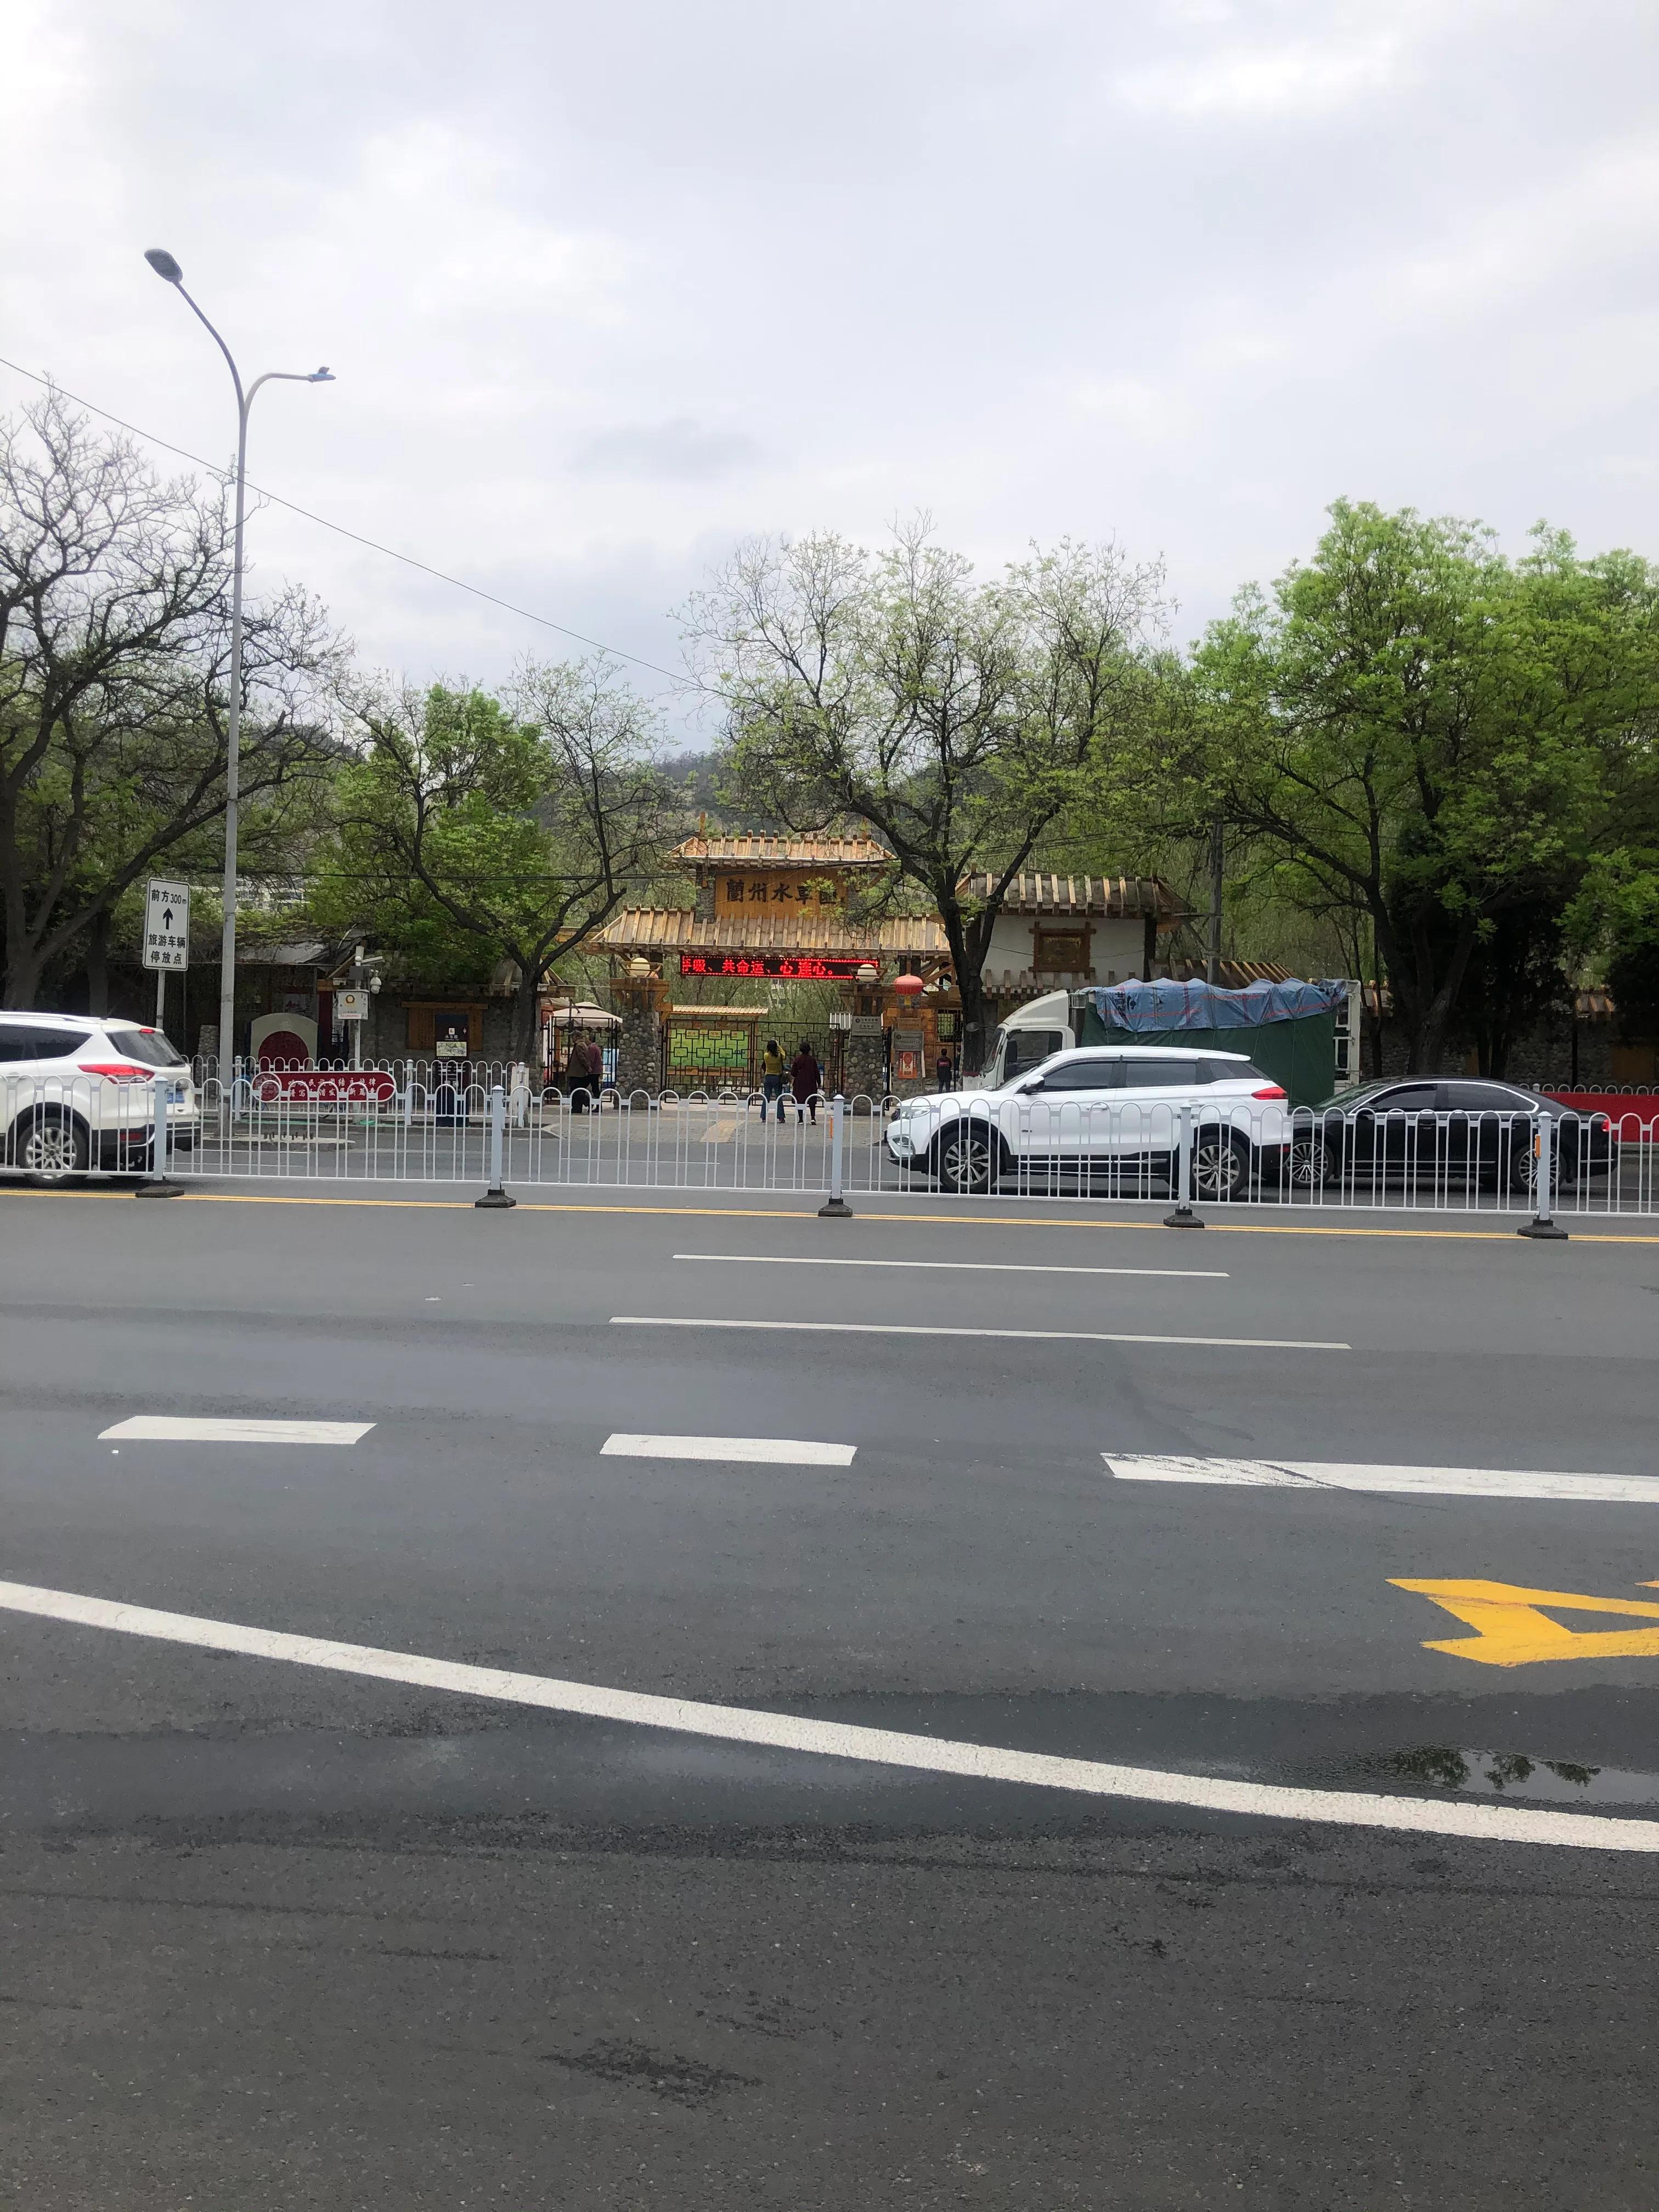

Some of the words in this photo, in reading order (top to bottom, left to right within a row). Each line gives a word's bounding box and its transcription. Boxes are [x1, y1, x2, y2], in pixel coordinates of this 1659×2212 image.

[151, 889, 187, 905] 前方300m
[148, 933, 185, 949] 旅游车辆
[151, 951, 182, 964] 停放点
